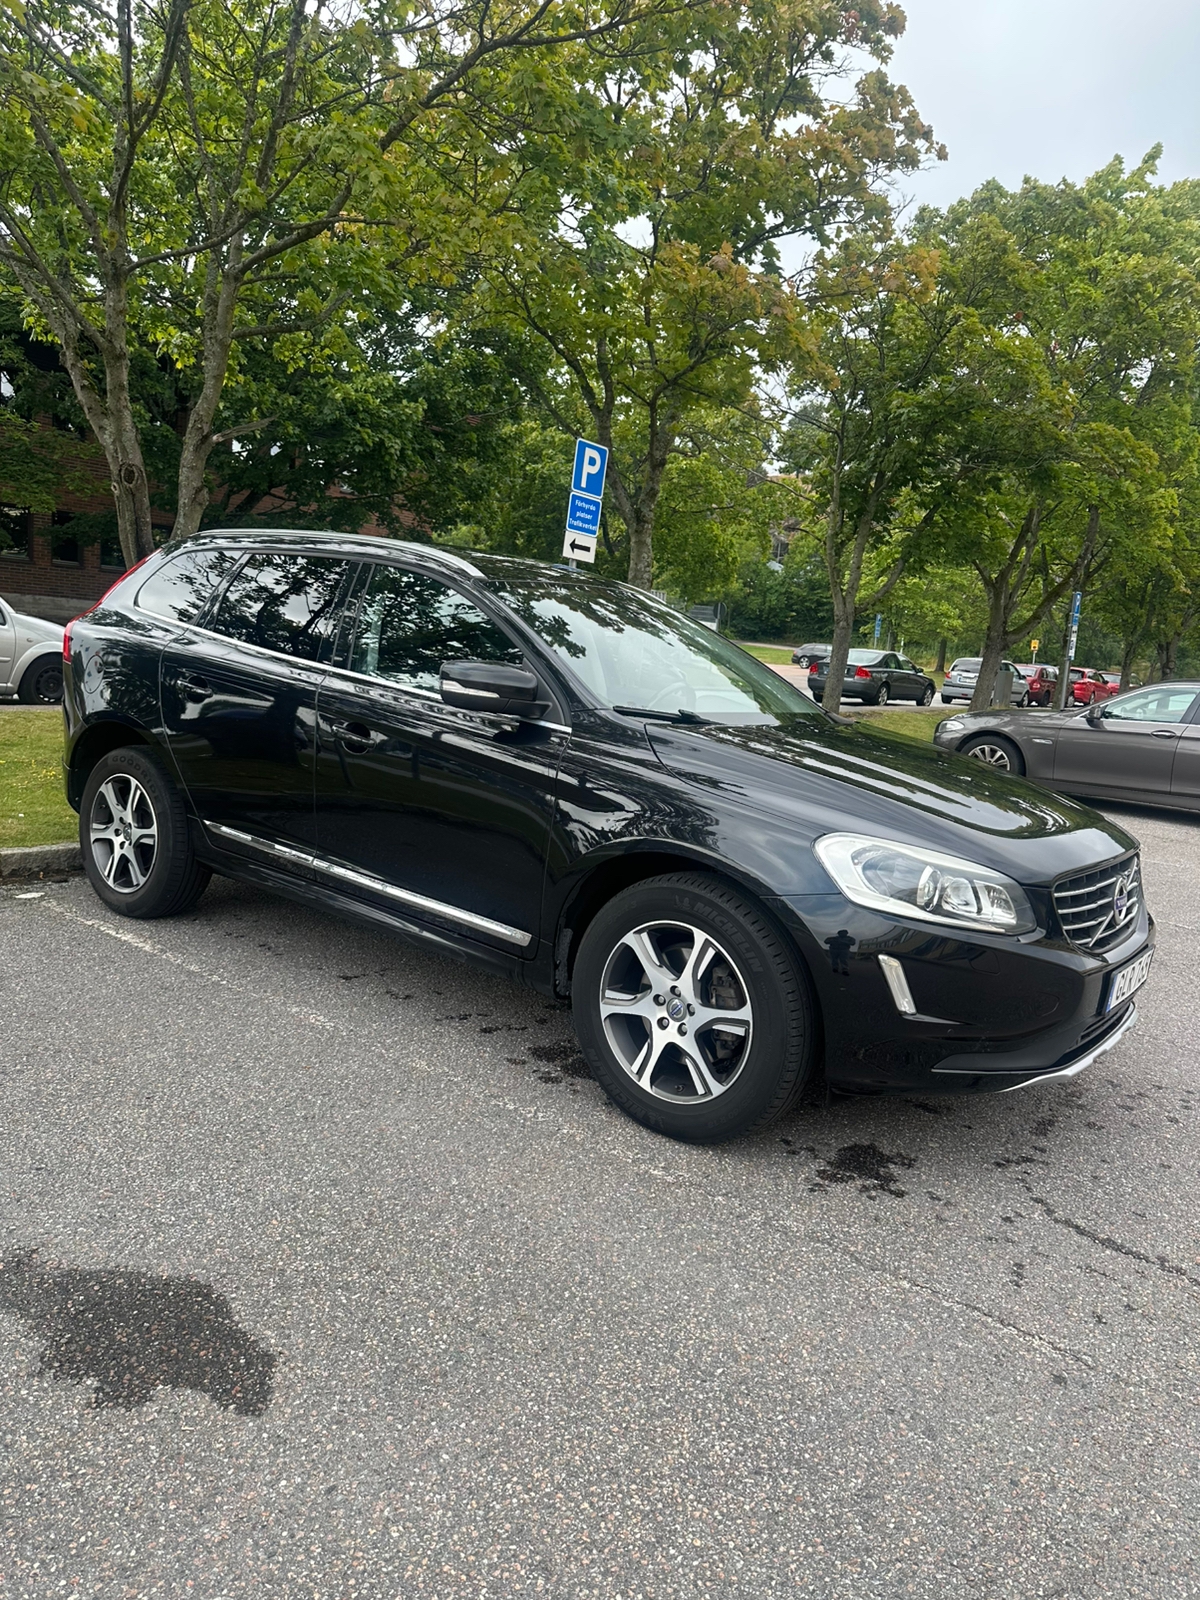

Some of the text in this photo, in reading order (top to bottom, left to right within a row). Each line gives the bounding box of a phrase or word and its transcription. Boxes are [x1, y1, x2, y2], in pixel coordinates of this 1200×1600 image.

[581, 446, 602, 489] P
[569, 518, 598, 531] Trafikverket
[576, 511, 593, 520] platser
[693, 902, 764, 973] MICHELIN
